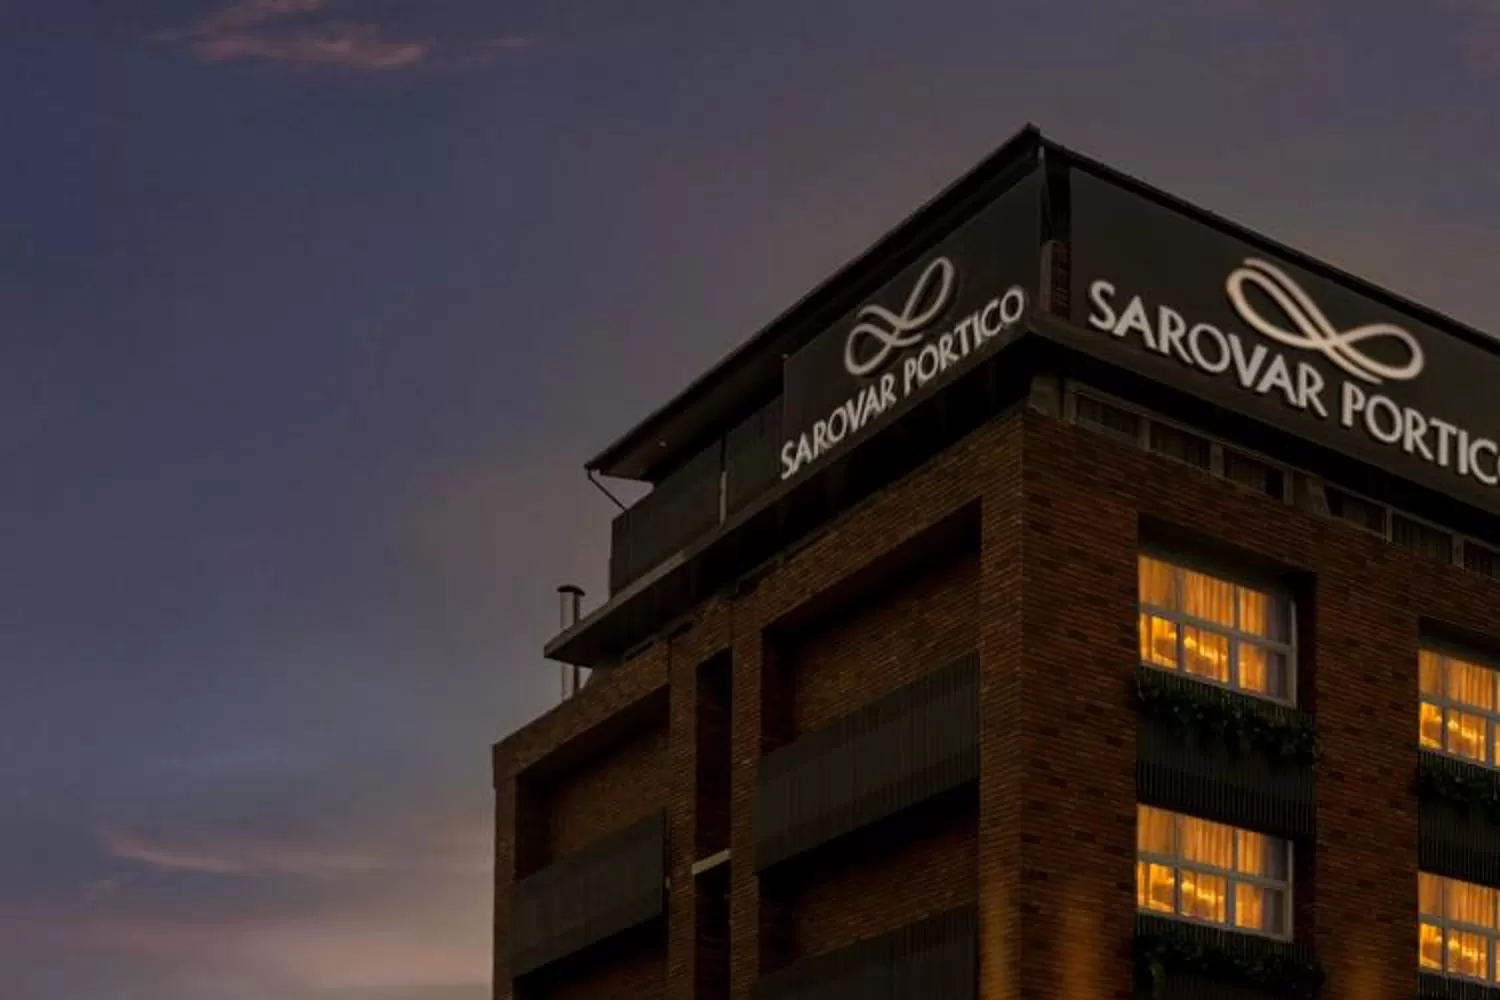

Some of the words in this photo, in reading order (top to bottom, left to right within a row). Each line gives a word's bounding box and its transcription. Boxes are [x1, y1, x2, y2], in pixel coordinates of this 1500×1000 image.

[781, 372, 897, 480] SAROVAR
[904, 287, 1025, 396] PORTICO
[1089, 280, 1327, 417] SAROVAR
